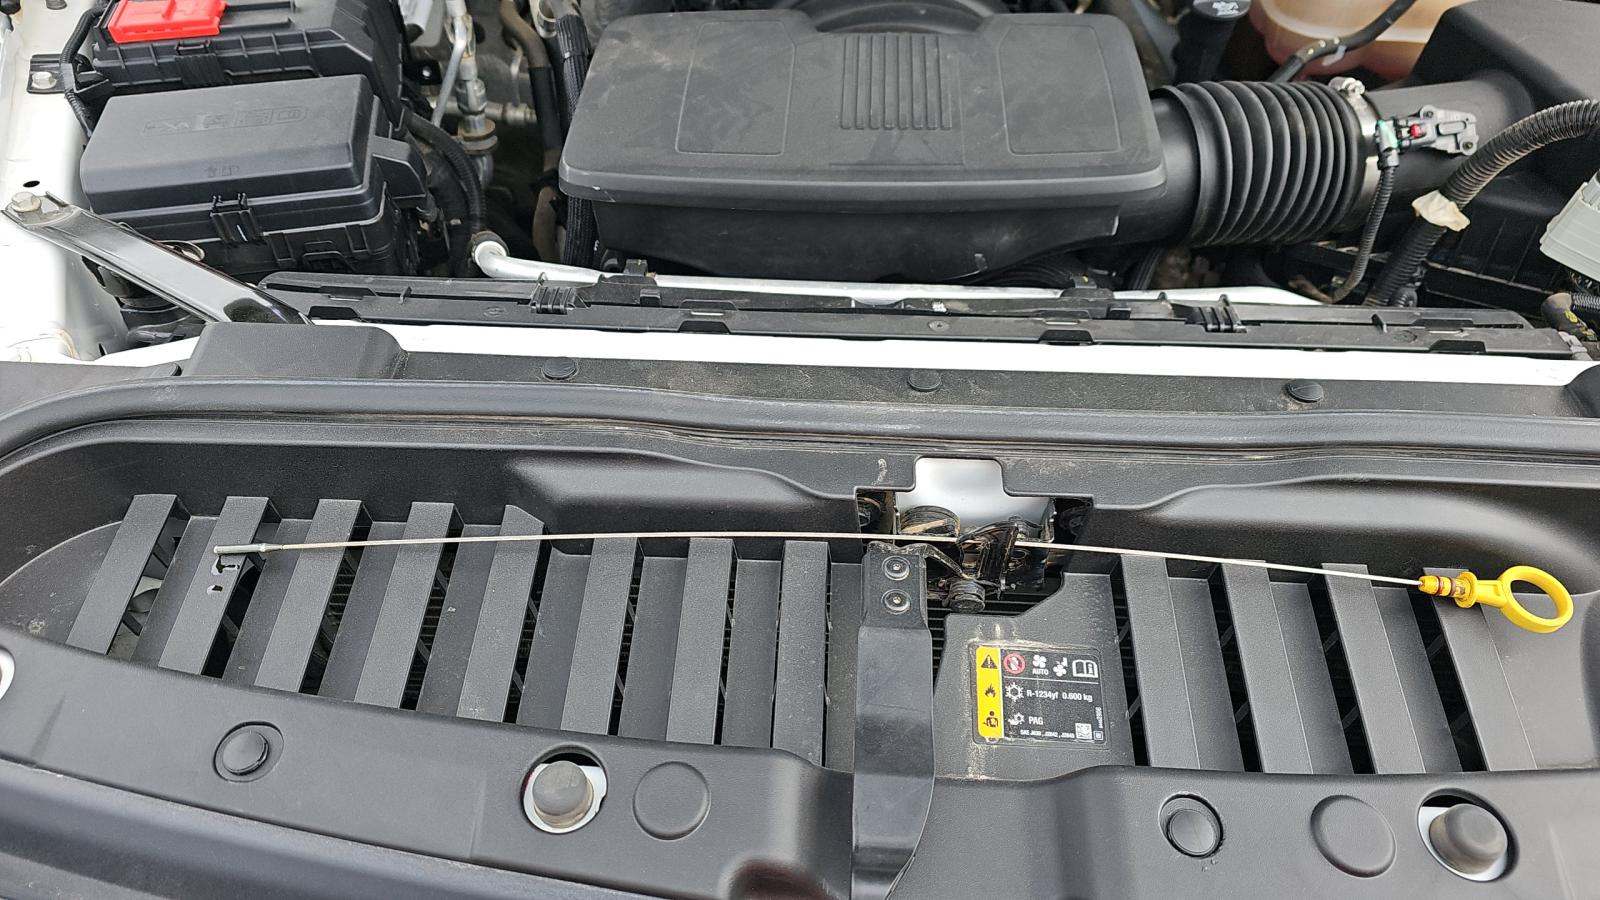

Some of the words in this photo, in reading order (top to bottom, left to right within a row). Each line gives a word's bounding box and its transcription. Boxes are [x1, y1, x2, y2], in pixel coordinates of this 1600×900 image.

[1032, 668, 1049, 676] AUTO
[1026, 689, 1058, 700] R-1234yf
[1062, 692, 1082, 701] 0.600
[1083, 694, 1093, 703] kg
[1028, 716, 1044, 725] PAG
